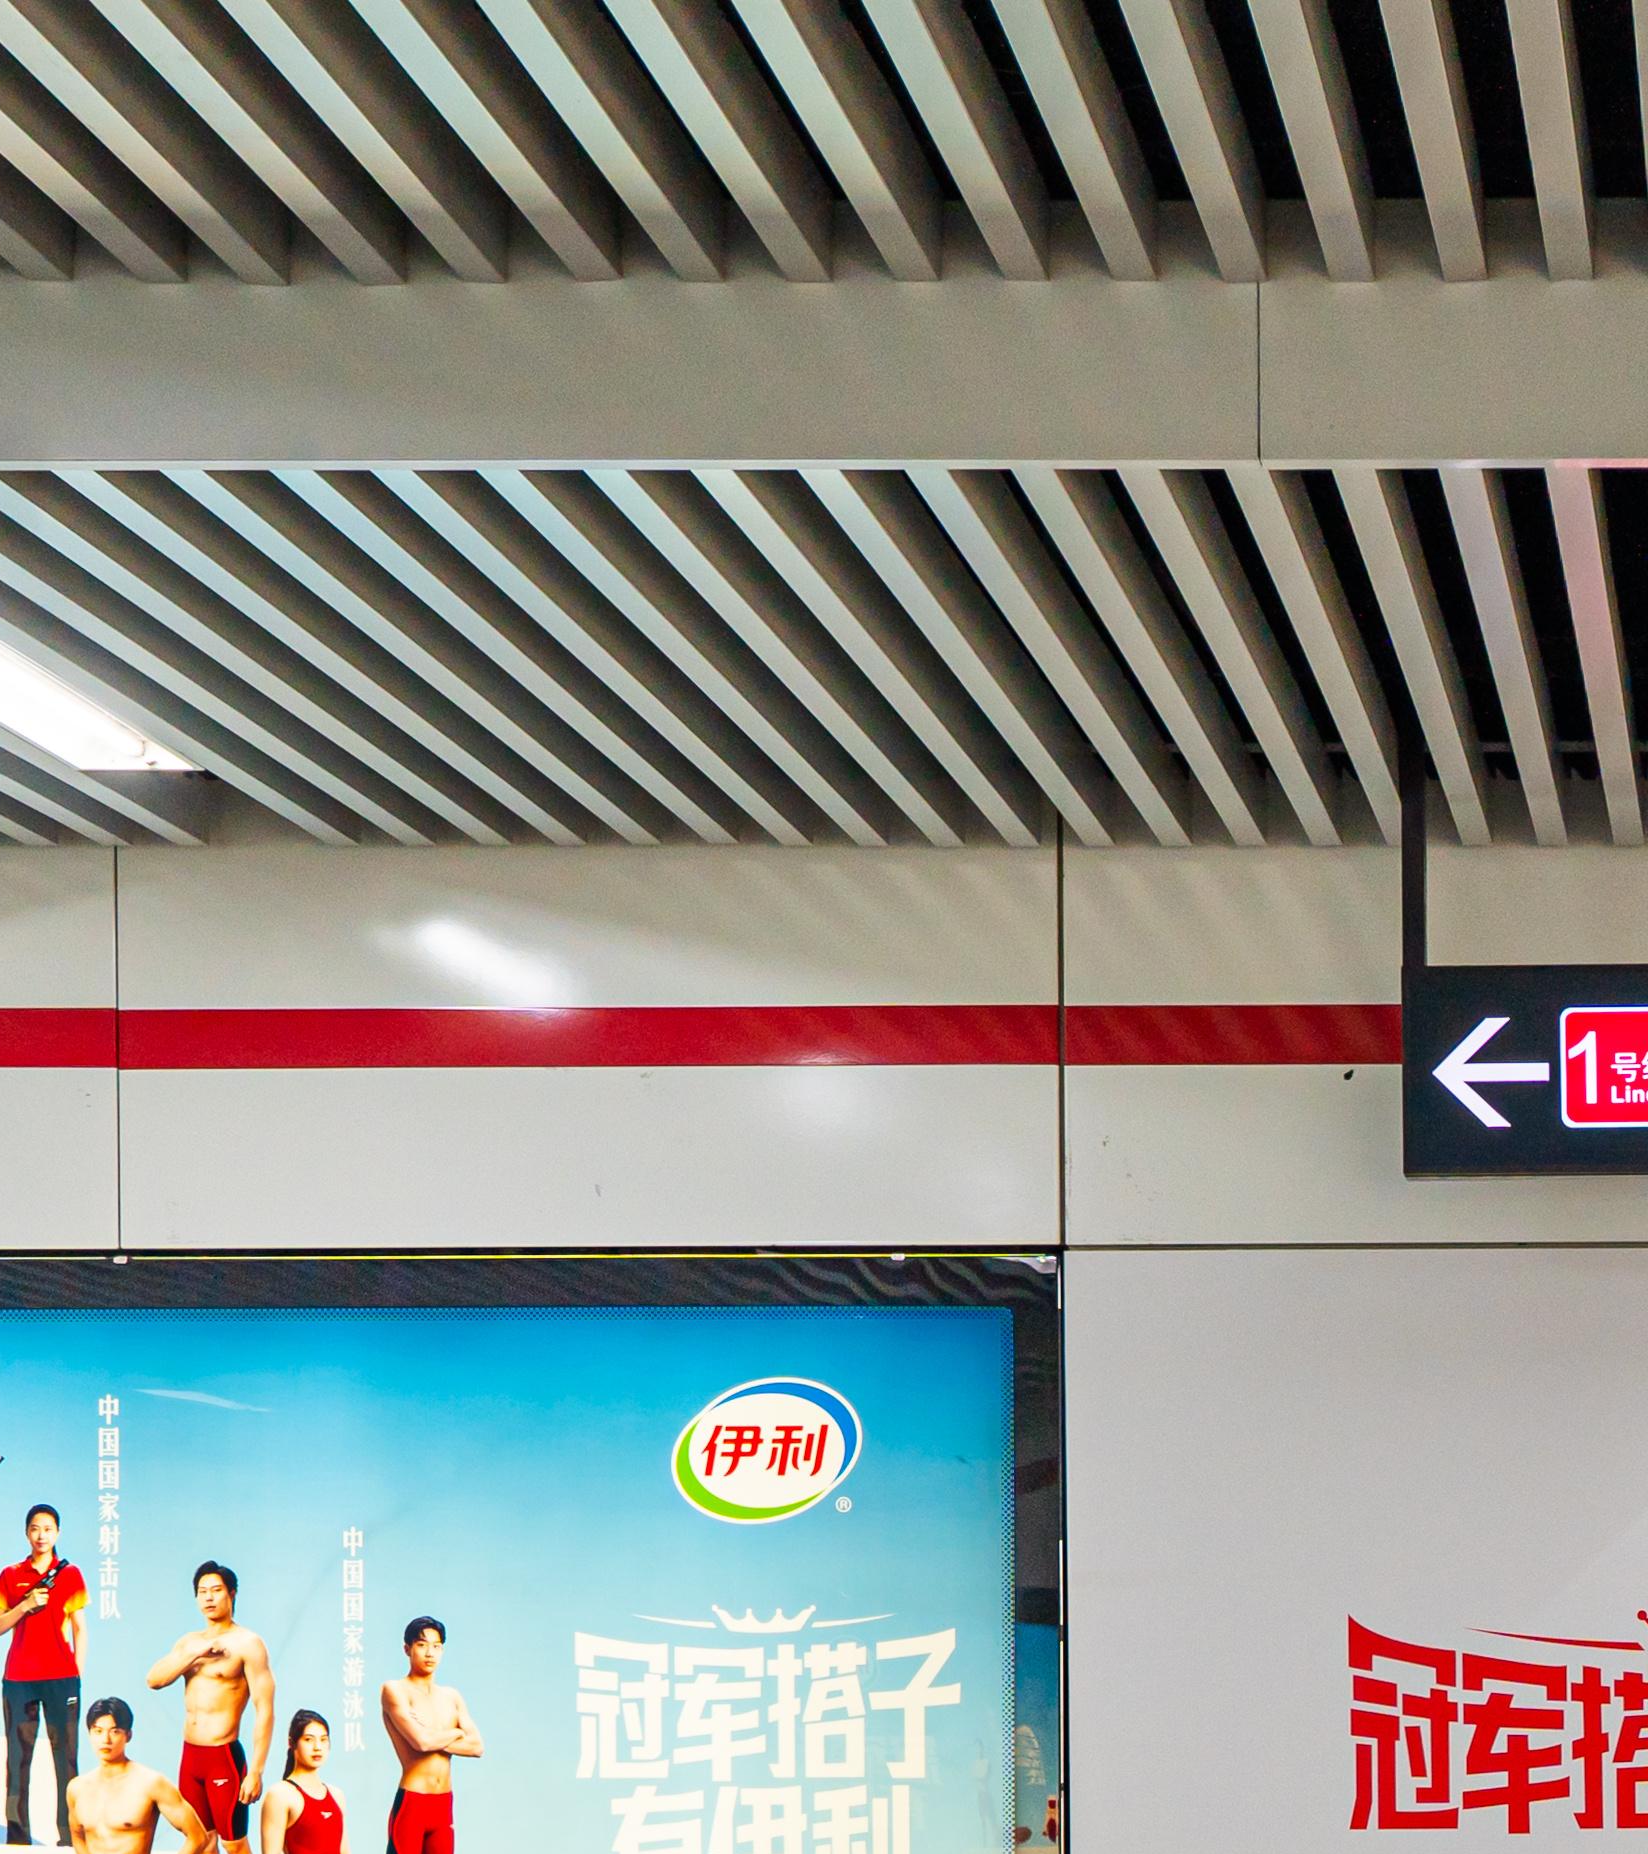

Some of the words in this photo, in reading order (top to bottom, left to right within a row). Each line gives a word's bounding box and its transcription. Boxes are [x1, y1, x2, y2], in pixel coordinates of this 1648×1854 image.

[97, 1393, 122, 1621] 中国国家射击队
[702, 1424, 829, 1478] 伊利
[342, 1525, 366, 1752] 中国国家游泳队
[572, 1626, 962, 1784] 冠军搭子
